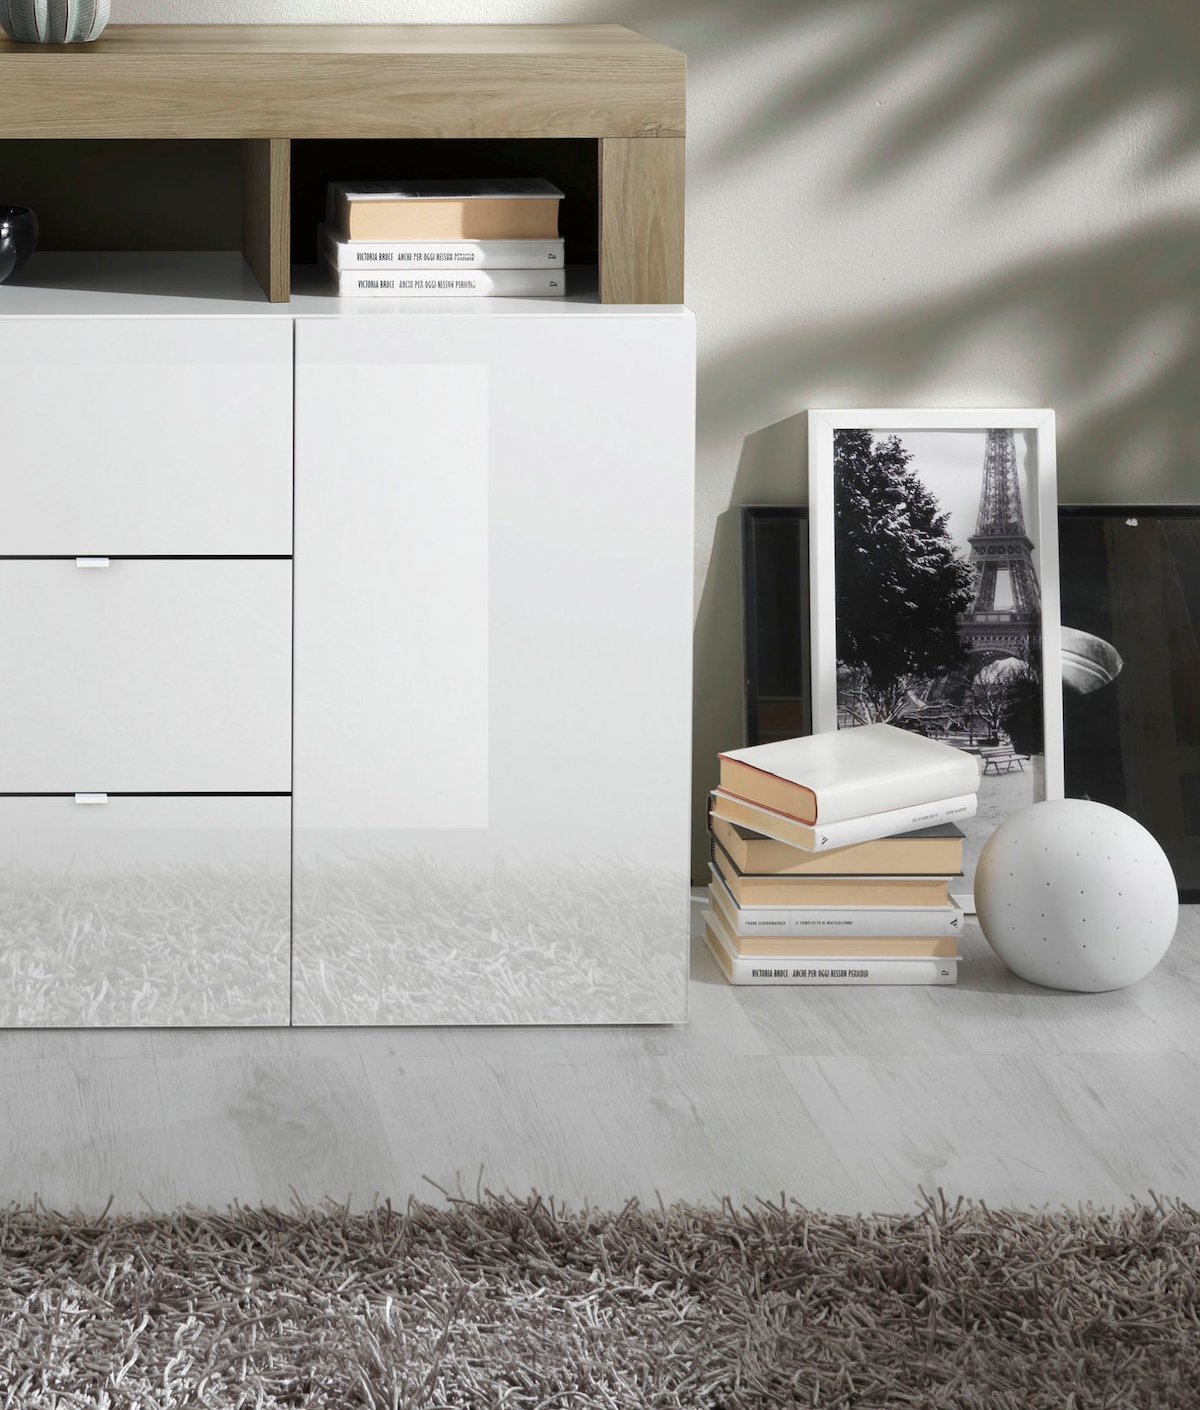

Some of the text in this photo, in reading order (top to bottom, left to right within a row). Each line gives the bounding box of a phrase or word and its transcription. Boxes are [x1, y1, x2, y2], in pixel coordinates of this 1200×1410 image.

[357, 252, 377, 261] VICTORIA
[398, 252, 412, 261] ANCHE
[358, 280, 378, 289] VICTORIA
[752, 969, 772, 978] VICTORIA
